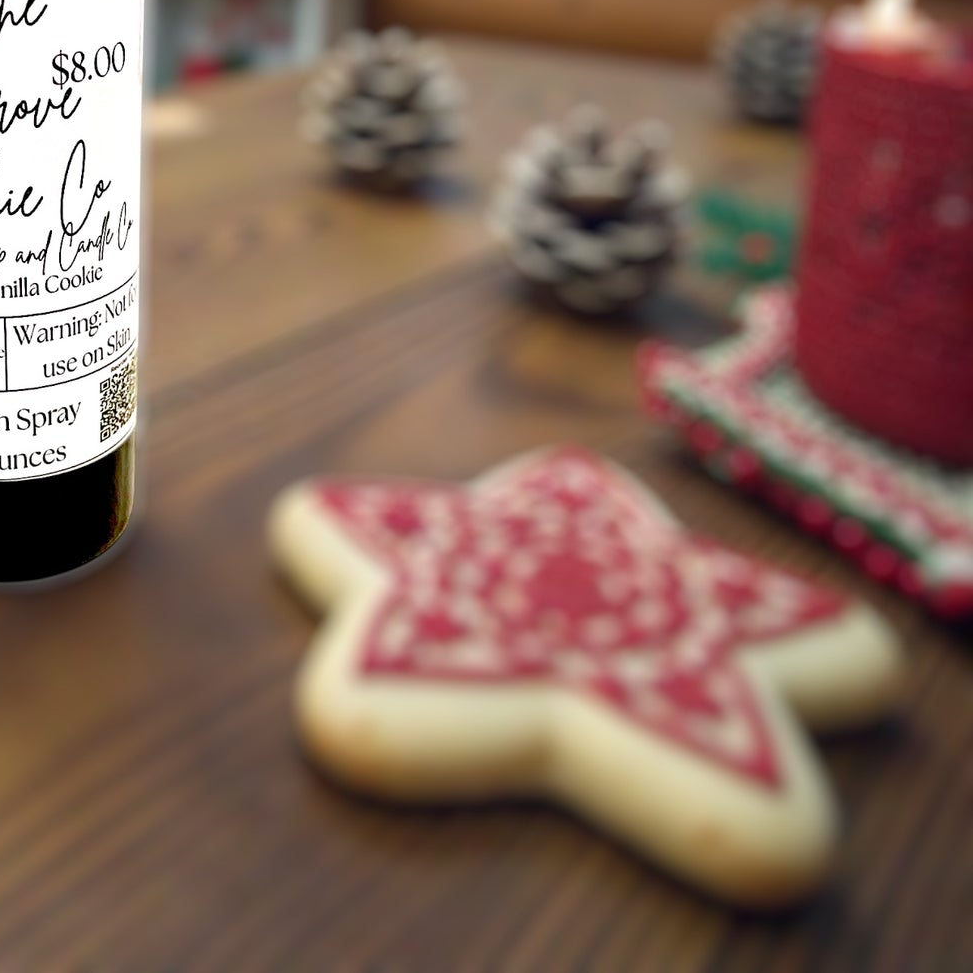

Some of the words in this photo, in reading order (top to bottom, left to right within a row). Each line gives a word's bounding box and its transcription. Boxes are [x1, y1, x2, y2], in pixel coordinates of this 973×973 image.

[52, 41, 126, 90] $8.00
[60, 139, 112, 236] Co
[15, 230, 53, 275] and
[44, 265, 103, 294] Cookie
[13, 311, 102, 346] Warning:
[104, 294, 126, 324] Not
[43, 356, 78, 378] use
[82, 346, 104, 368] on
[107, 327, 130, 357] Skin
[16, 401, 81, 437] Spray
